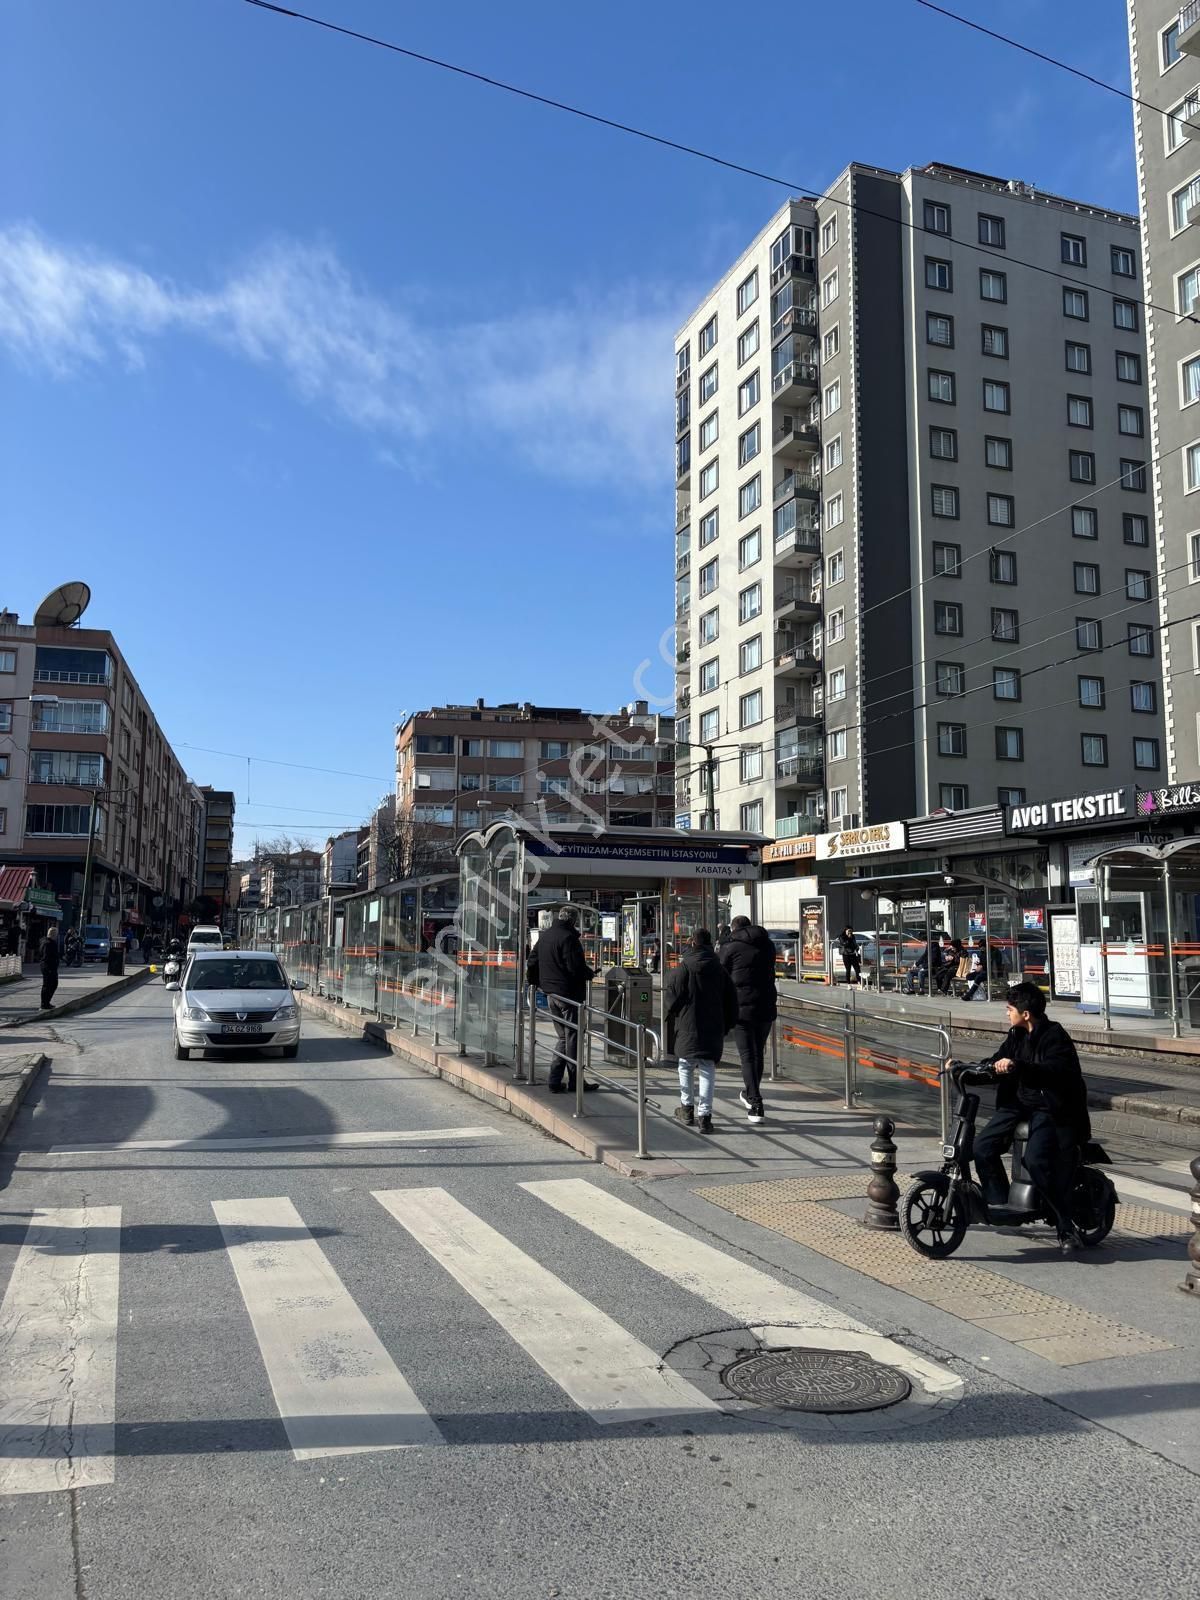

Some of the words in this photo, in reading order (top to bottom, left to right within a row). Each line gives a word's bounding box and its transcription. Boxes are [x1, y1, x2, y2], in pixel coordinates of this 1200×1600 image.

[1011, 803, 1048, 829] AVCI
[671, 847, 718, 859] İSTASYONU
[695, 865, 733, 876] KABATAŞ
[225, 1024, 234, 1033] 34
